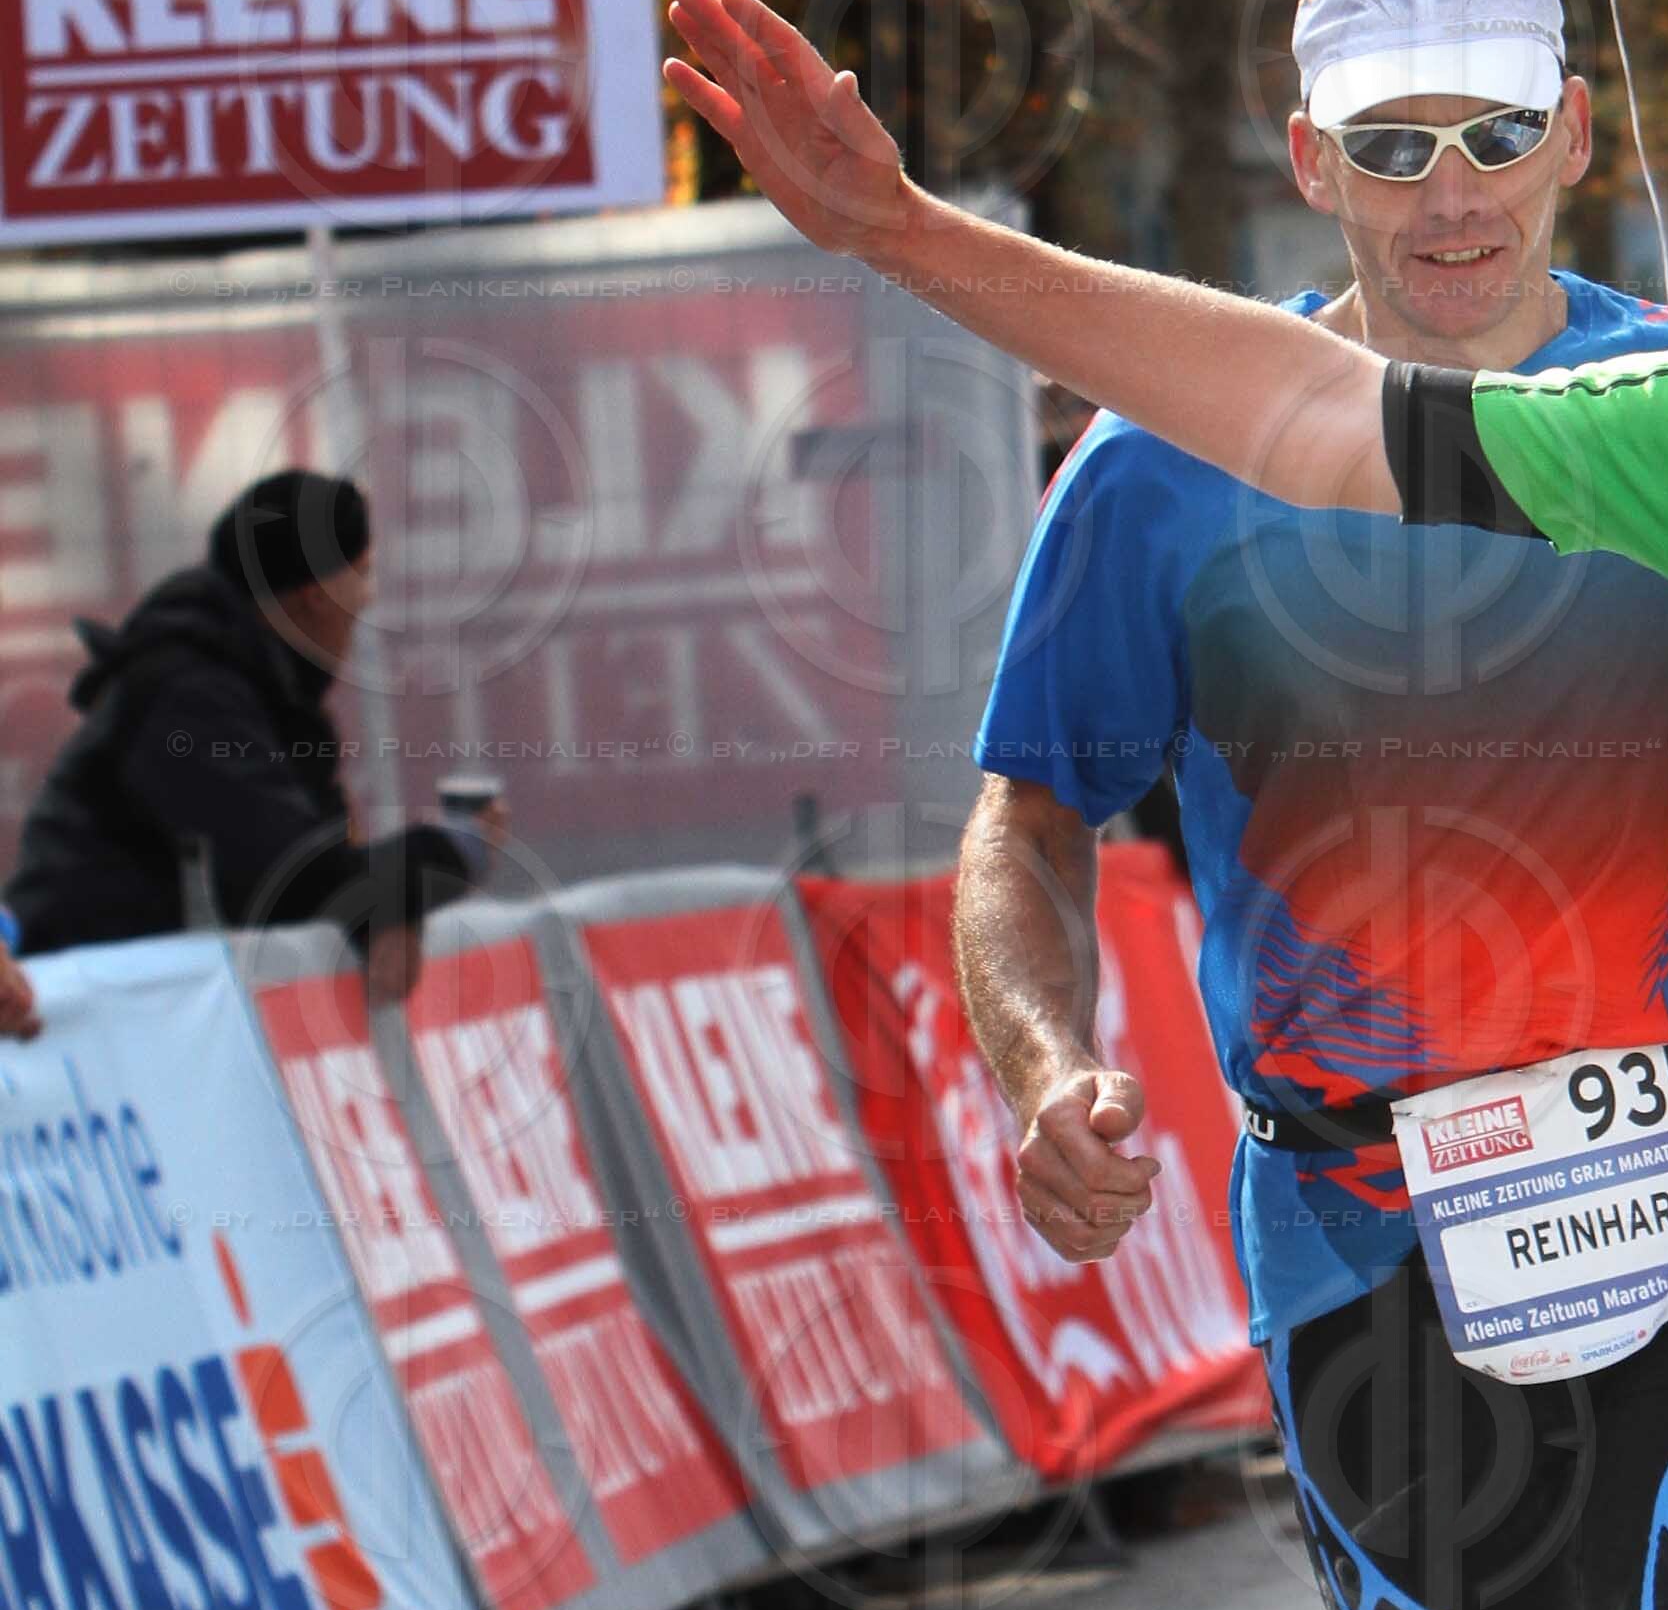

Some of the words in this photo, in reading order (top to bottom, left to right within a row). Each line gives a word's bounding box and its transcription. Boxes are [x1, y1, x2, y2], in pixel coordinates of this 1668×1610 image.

[26, 64, 569, 191] ZEITUNG
[1426, 1100, 1523, 1146] KLEINE
[1432, 1129, 1532, 1171] ZEITUNG
[1432, 1188, 1493, 1221] KLEINE
[1495, 1169, 1567, 1204] ZEITUNG
[1570, 1158, 1616, 1185] GRAZ
[1463, 1314, 1525, 1345] Kleine
[1527, 1294, 1600, 1331] Zeitung
